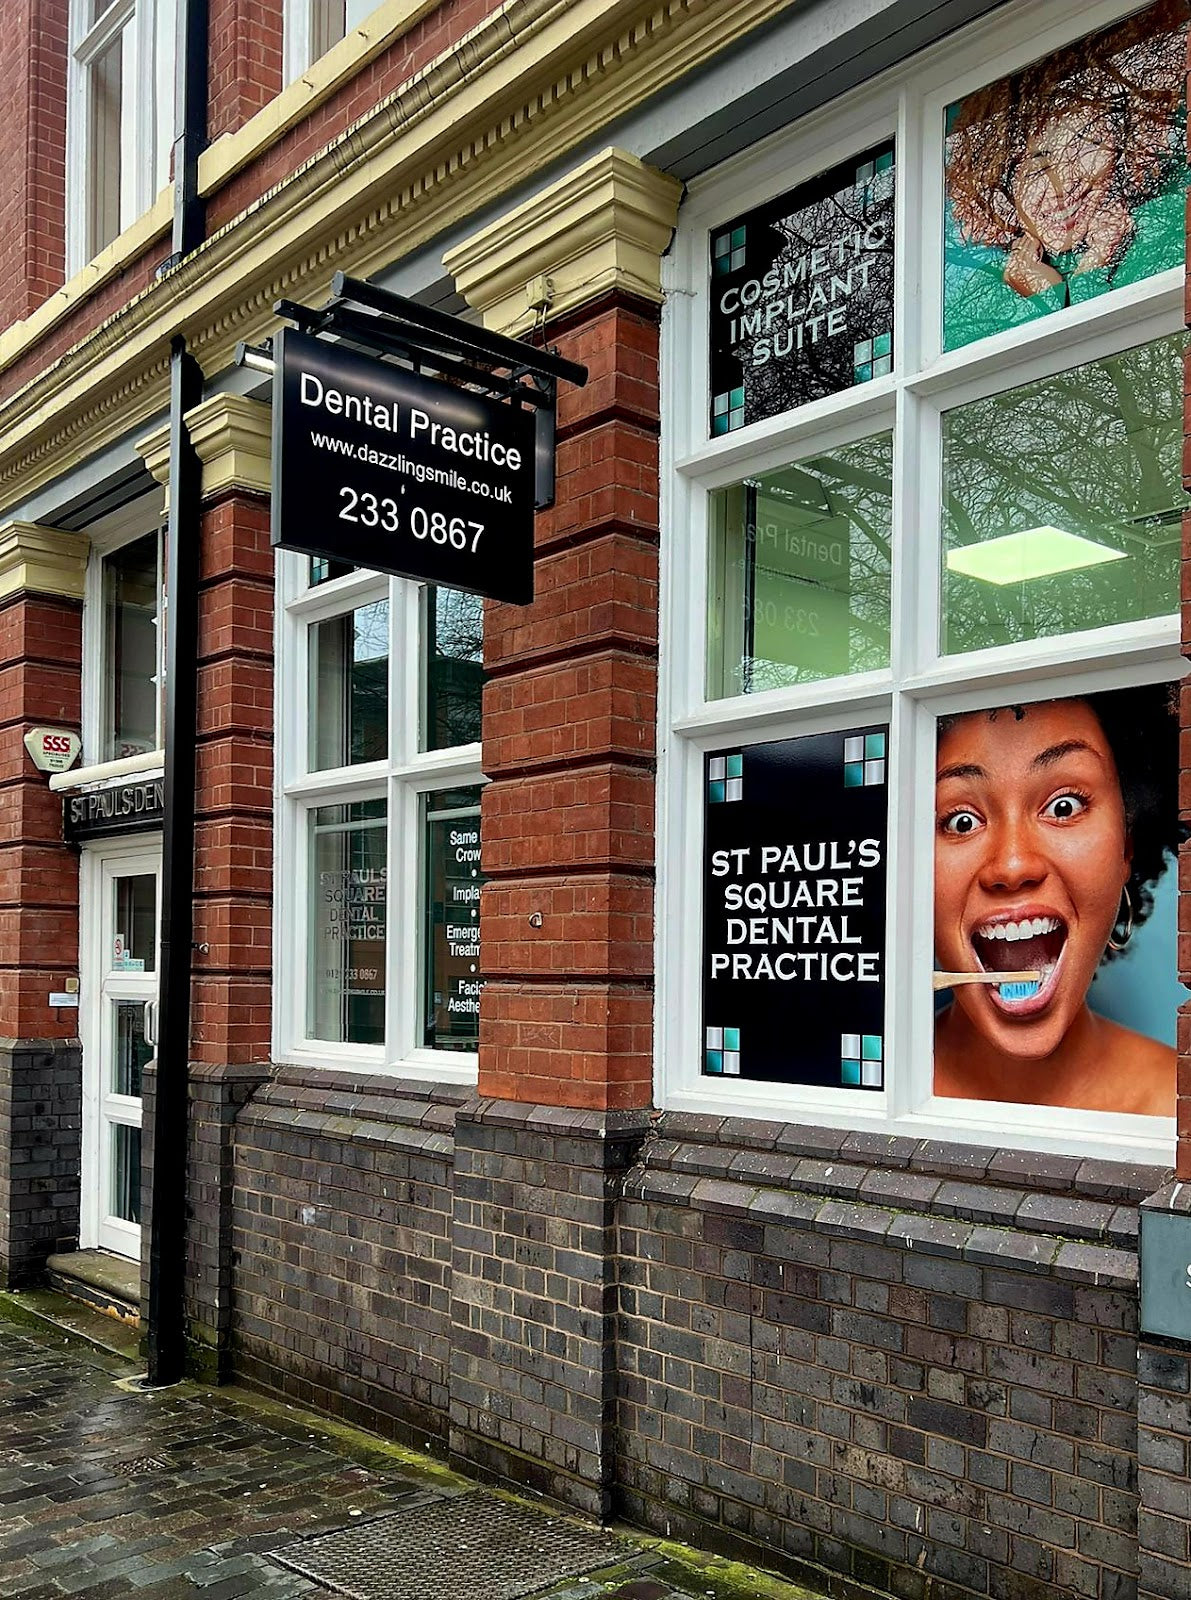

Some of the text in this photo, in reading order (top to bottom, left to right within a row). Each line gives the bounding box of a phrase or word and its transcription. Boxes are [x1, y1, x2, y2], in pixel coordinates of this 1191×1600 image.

[720, 221, 887, 315] COSMETIC
[730, 259, 876, 345] IMPLANT
[752, 307, 848, 366] SUITE
[300, 372, 522, 471] Dental Practice
[310, 431, 513, 504] www.dazzlingsmile.co.uk
[338, 486, 485, 553] 233 0867
[43, 735, 71, 753] SSS
[70, 796, 87, 824] ST
[88, 787, 134, 820] PAULS
[449, 830, 478, 846] Same
[455, 847, 482, 863] Crow
[711, 848, 751, 877] ST
[325, 886, 385, 903] SQUARE
[452, 885, 483, 904] Impla
[724, 876, 864, 914] SQUARE
[329, 906, 379, 921] DENTAL
[324, 925, 385, 940] PRACTICE
[726, 915, 862, 945] DENTAL
[711, 951, 880, 983] PRACTICE
